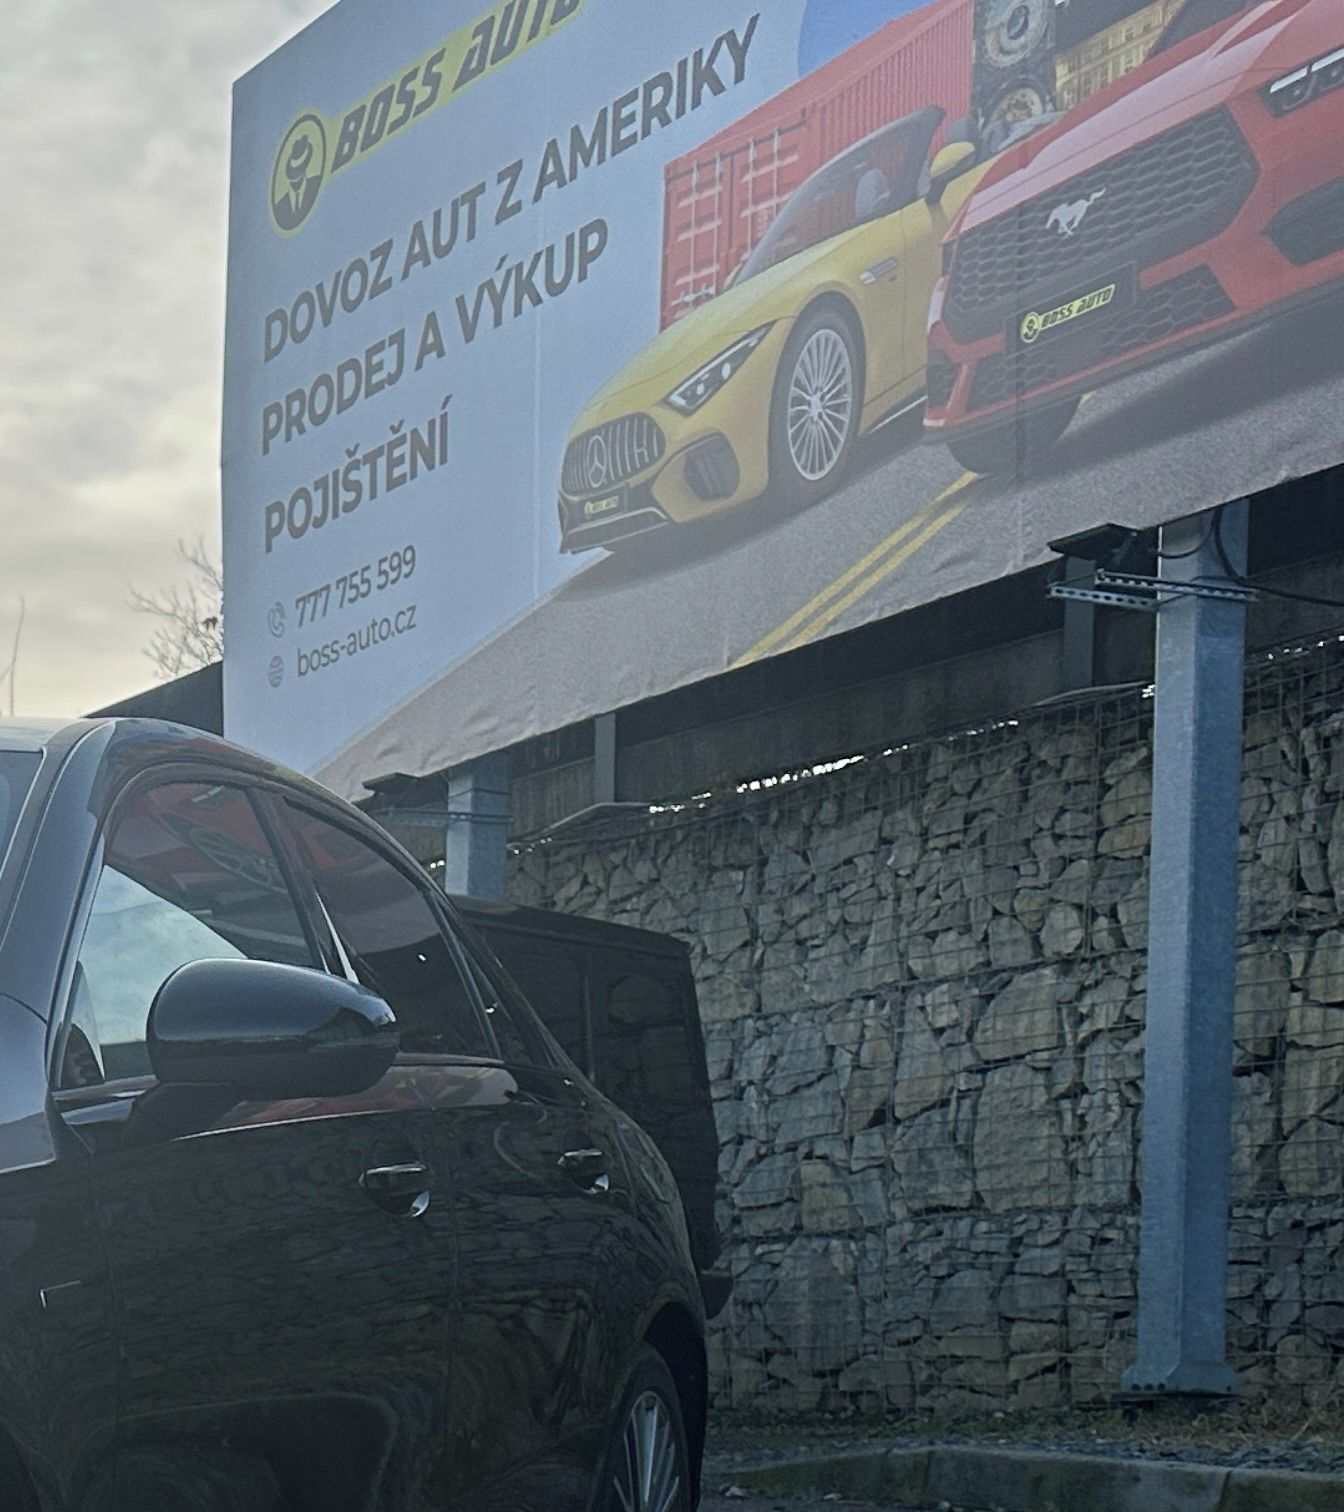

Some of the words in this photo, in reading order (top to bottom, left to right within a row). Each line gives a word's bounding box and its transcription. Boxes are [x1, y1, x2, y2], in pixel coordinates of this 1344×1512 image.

[330, 47, 447, 174] BOSS
[264, 238, 394, 363] DOVOZ
[401, 182, 487, 280] AUT
[494, 158, 524, 227] Z
[531, 13, 761, 204] AMERIKY
[261, 328, 406, 455] PRODEJ
[414, 311, 446, 371] A
[455, 218, 609, 344] VÝKUP
[1076, 287, 1113, 314] AUTO
[264, 394, 453, 554] POJIŠTĚNÍ
[294, 584, 332, 628] 777
[334, 565, 373, 610] 755
[377, 544, 417, 592] 599
[297, 603, 418, 677] boss-auto.cz
